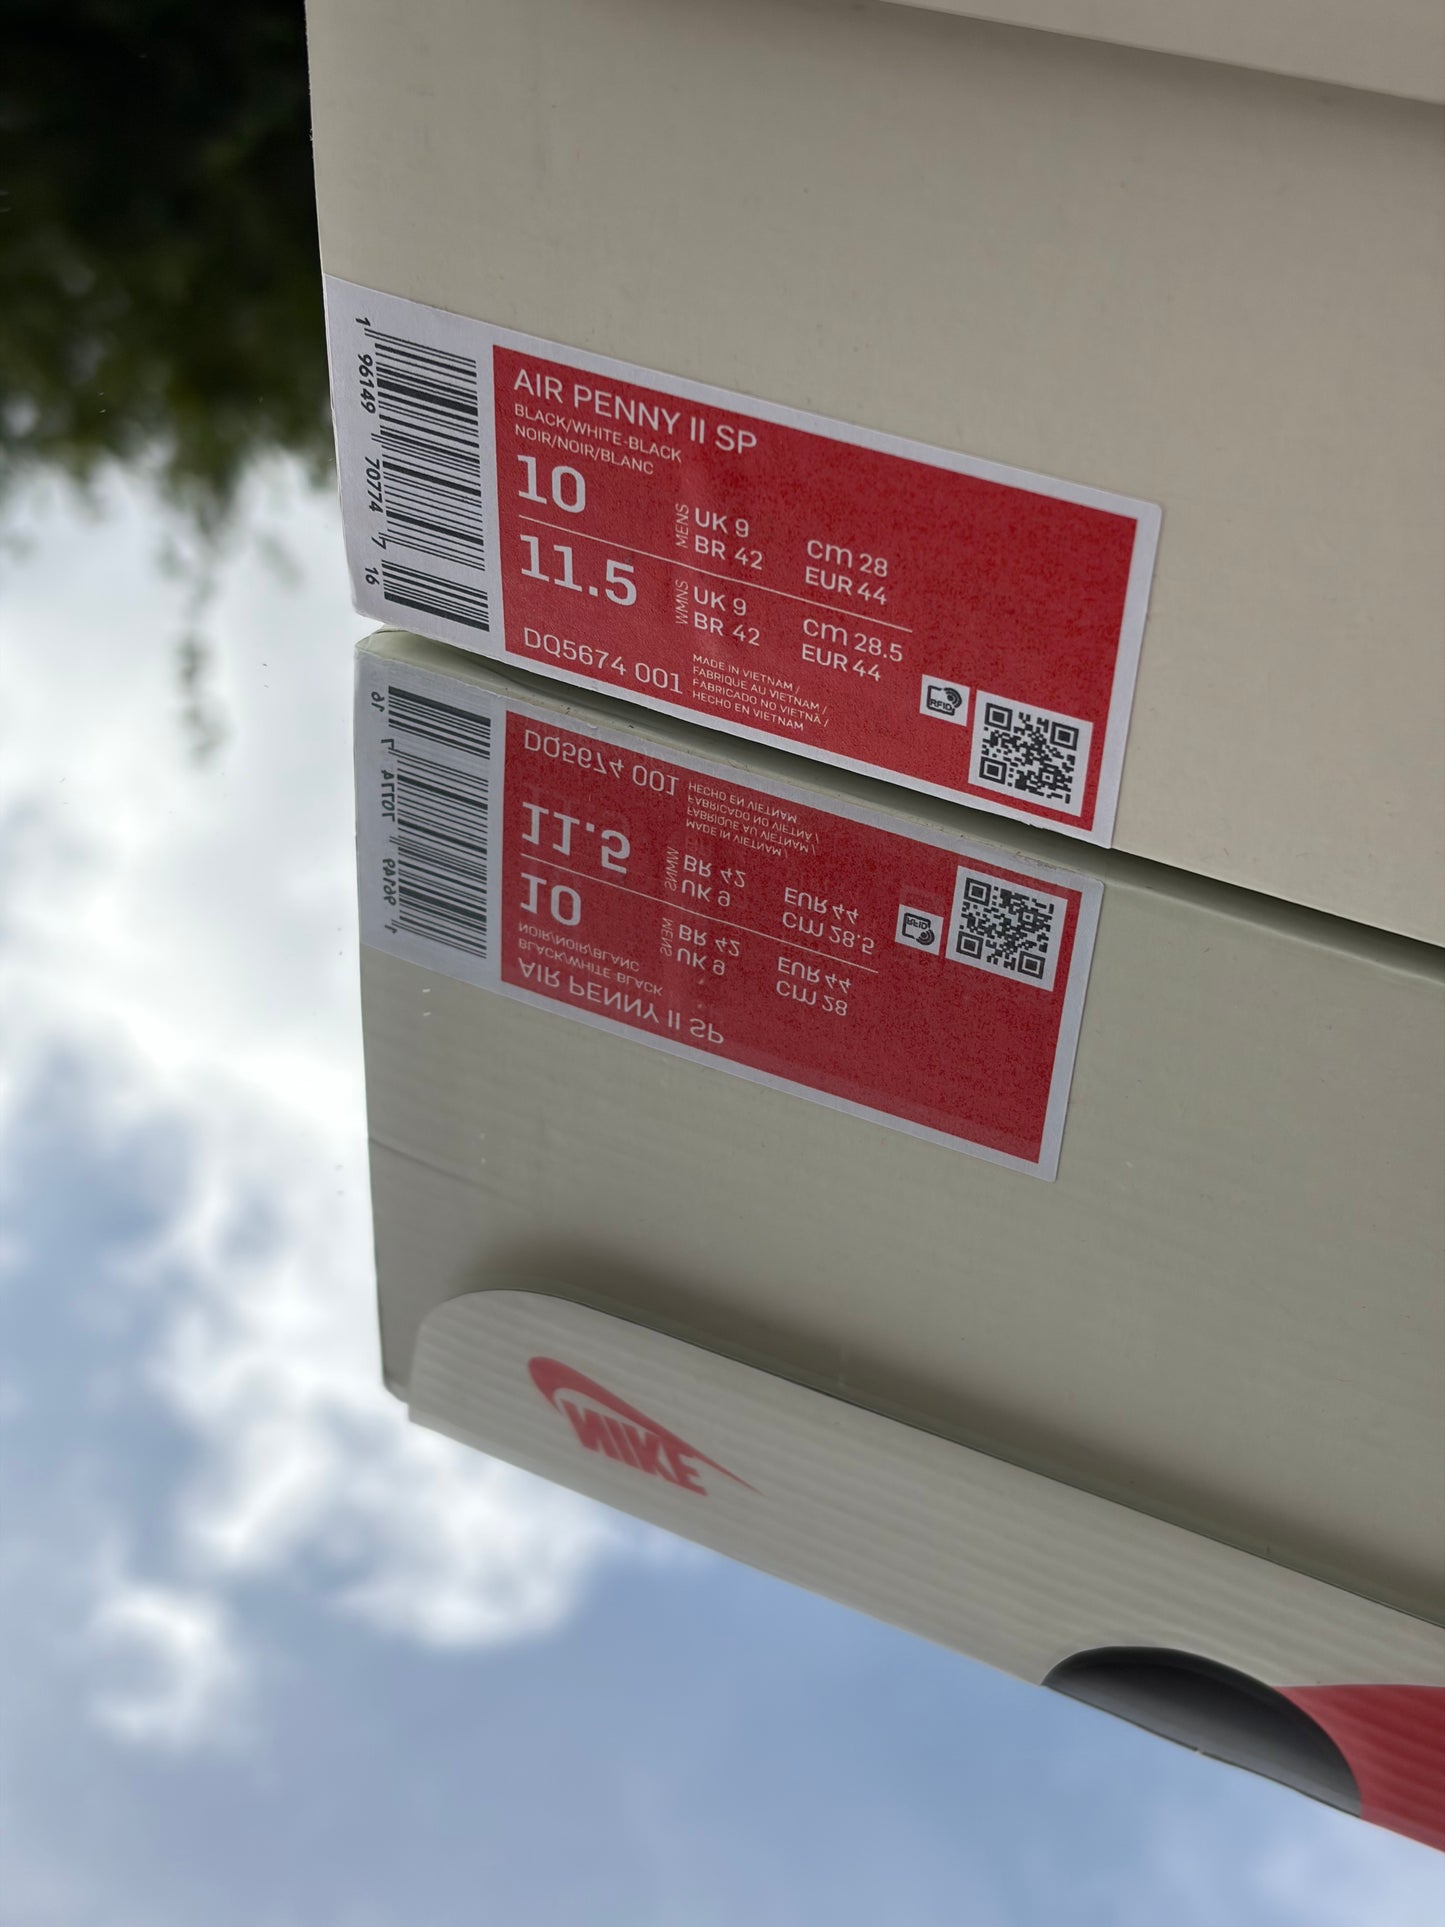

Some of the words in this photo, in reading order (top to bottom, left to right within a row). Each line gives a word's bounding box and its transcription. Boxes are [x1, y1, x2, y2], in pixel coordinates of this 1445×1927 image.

[355, 317, 371, 328] 1
[357, 354, 376, 414] 96149
[513, 369, 563, 403] AIR
[574, 384, 681, 434] PENNY
[690, 417, 705, 444] II
[715, 425, 757, 454] SP
[514, 404, 682, 463] BLACK/WHITE-BLACK
[515, 423, 654, 475] NOIR/NOIR/BLANC
[364, 456, 383, 513] 70774
[517, 454, 586, 513] 10
[675, 503, 689, 548] MENS
[695, 506, 728, 534] UK
[735, 518, 749, 538] 9
[371, 536, 387, 550] 7
[694, 534, 726, 561] BR
[734, 547, 764, 570] 42
[807, 539, 853, 569] cm
[859, 554, 888, 578] 28
[365, 567, 379, 585] 16
[519, 534, 637, 606] 11.5
[805, 567, 852, 596] EUR
[857, 582, 887, 605] 44
[675, 579, 689, 625] WMNS
[693, 585, 726, 612] UK
[733, 597, 747, 617] 9
[693, 611, 724, 637] BR
[732, 623, 760, 646] 42
[803, 618, 848, 647] cm
[853, 632, 903, 662] 28.5
[524, 627, 626, 676] DQ5674
[635, 663, 683, 695] 001
[693, 654, 725, 670] MADE
[728, 663, 742, 675] IN
[742, 667, 793, 691] VIETNAM
[802, 644, 847, 672] EUR
[852, 659, 881, 682] 44
[693, 666, 748, 691] FABRIQUE
[750, 684, 767, 696] AU
[770, 689, 820, 711] VIETNAM
[693, 678, 757, 705] FABRICADO
[760, 698, 777, 711] NO
[930, 699, 952, 711] RFID
[692, 691, 731, 711] HECHO
[735, 703, 750, 715] EN
[752, 707, 804, 731] VIETNAM
